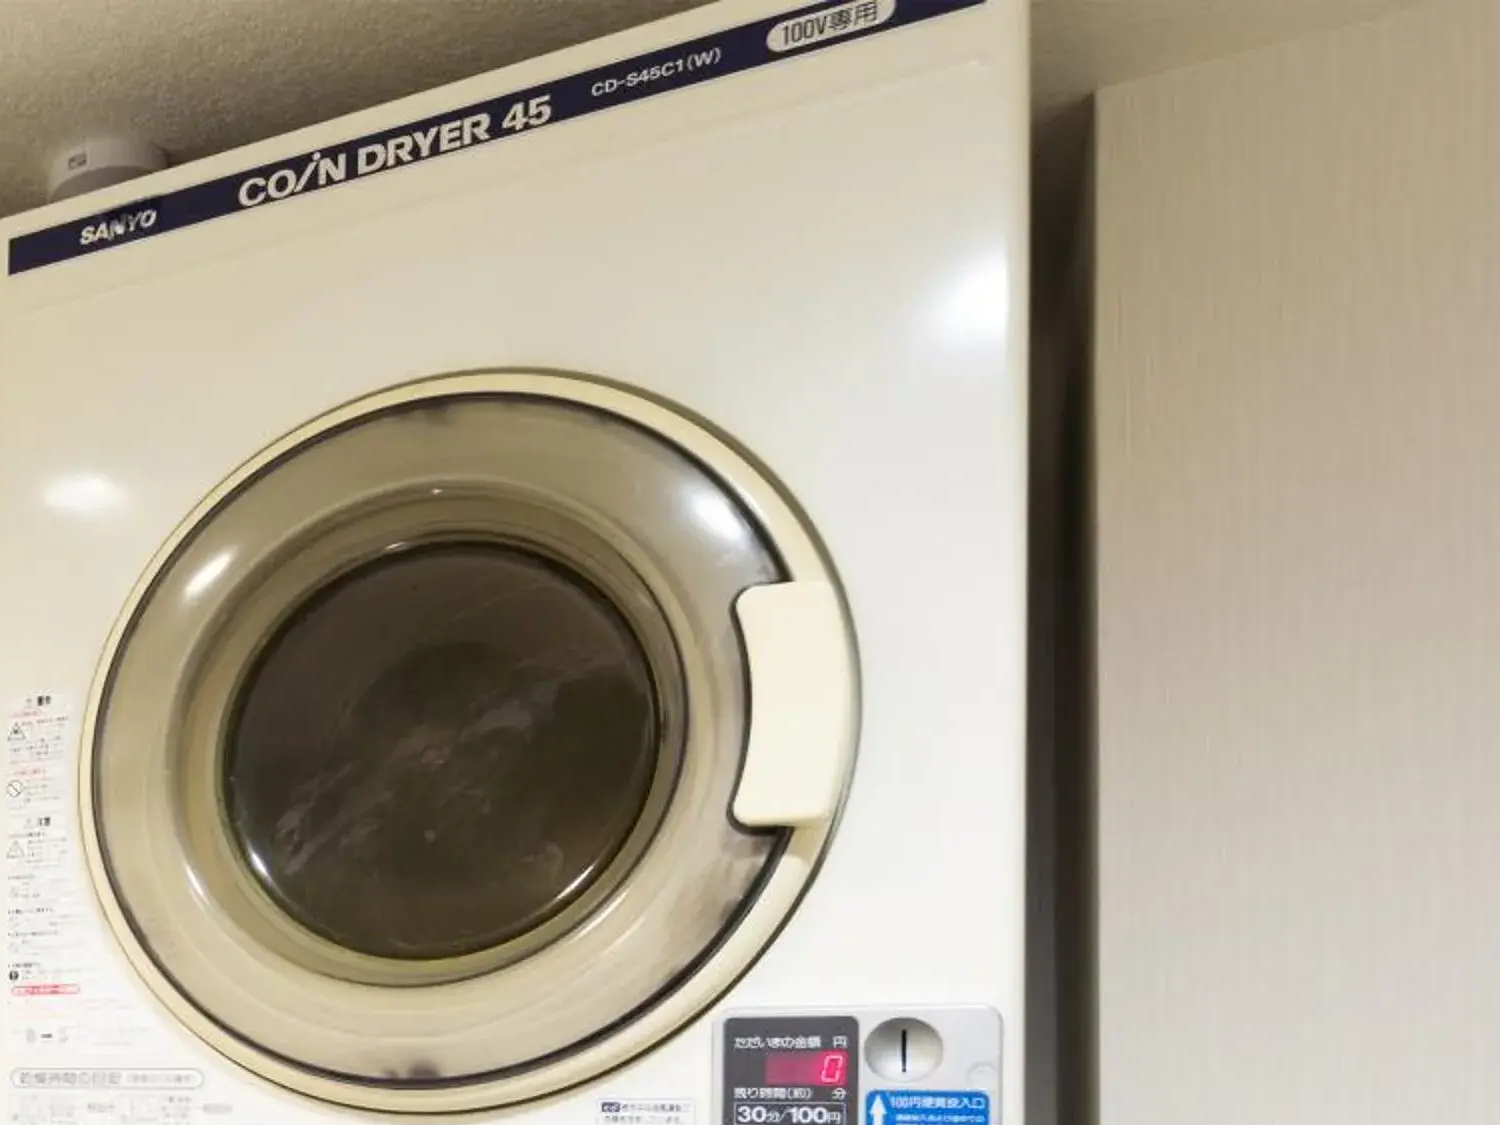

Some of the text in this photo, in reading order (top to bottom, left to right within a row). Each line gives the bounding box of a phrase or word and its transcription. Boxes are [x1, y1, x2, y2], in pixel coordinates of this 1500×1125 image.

[782, 1, 878, 46] 100V専用
[591, 47, 722, 96] CD-S45C1(W)
[238, 95, 553, 208] COIN DRYER 45
[79, 208, 156, 246] SANYO
[832, 1035, 847, 1049] 円
[821, 1055, 843, 1082] 0
[832, 1087, 847, 1099] 分
